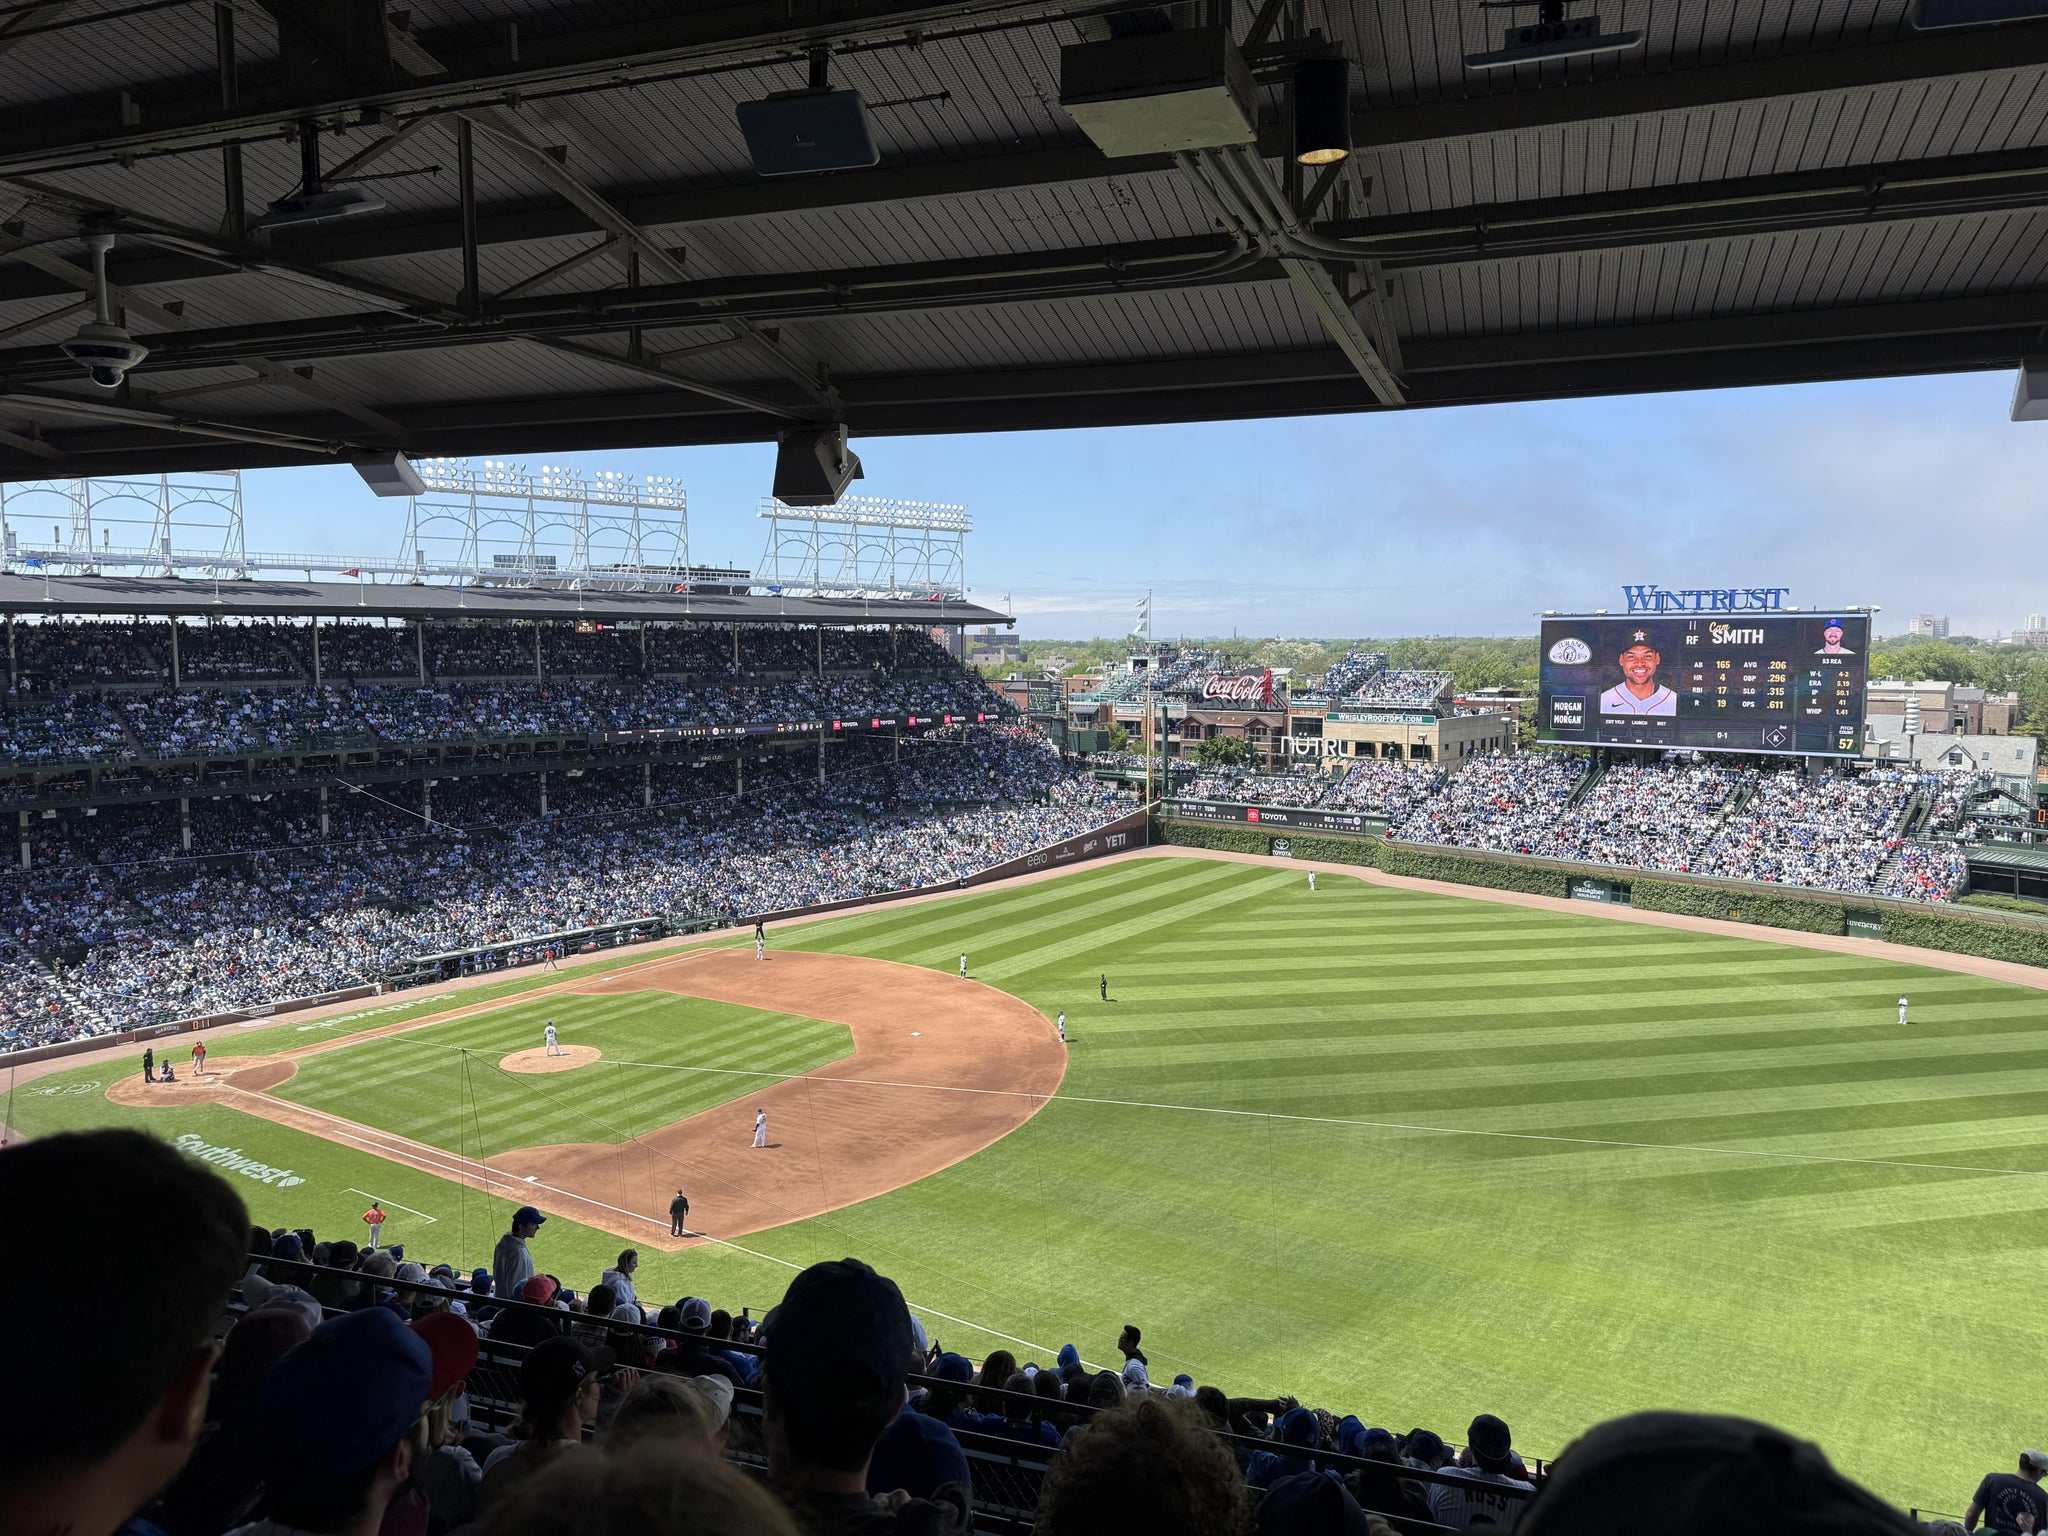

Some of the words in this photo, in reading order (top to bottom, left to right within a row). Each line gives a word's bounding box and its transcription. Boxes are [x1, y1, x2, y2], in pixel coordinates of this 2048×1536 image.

[1621, 585, 1790, 612] WINTRUST
[1709, 621, 1730, 634] Cam
[1686, 635, 1699, 645] RF
[1712, 629, 1764, 645] SMITH
[1557, 640, 1586, 650] TURANO
[1716, 661, 1731, 669] 165
[1767, 661, 1787, 670] .206
[1719, 673, 1726, 682] 4
[1767, 675, 1786, 683] .296
[1203, 673, 1265, 702] Coca-Cola
[1836, 680, 1850, 688] 5.19
[1692, 686, 1703, 694] RBI
[1718, 686, 1727, 695] 17
[1766, 688, 1785, 697] .315
[1836, 689, 1850, 697] 50.1
[1554, 702, 1582, 712] MORGAN
[1717, 700, 1727, 708] 19
[1766, 700, 1784, 710] .611
[1836, 708, 1848, 716] 1.41
[1338, 713, 1423, 723] WRIGLEYROOFTOPS.COM
[1553, 714, 1582, 725] MORGAN
[1772, 734, 1780, 743] K
[1838, 738, 1854, 750] 57
[1260, 812, 1288, 822] TOYOTA
[1105, 832, 1126, 848] YETI
[1027, 852, 1048, 867] eero
[1572, 885, 1605, 896] Gallagher
[1846, 918, 1881, 931] Invenergy
[248, 1005, 275, 1015] GRAINGER
[154, 1025, 181, 1036] MARQUEE
[176, 1133, 294, 1184] Southwest
